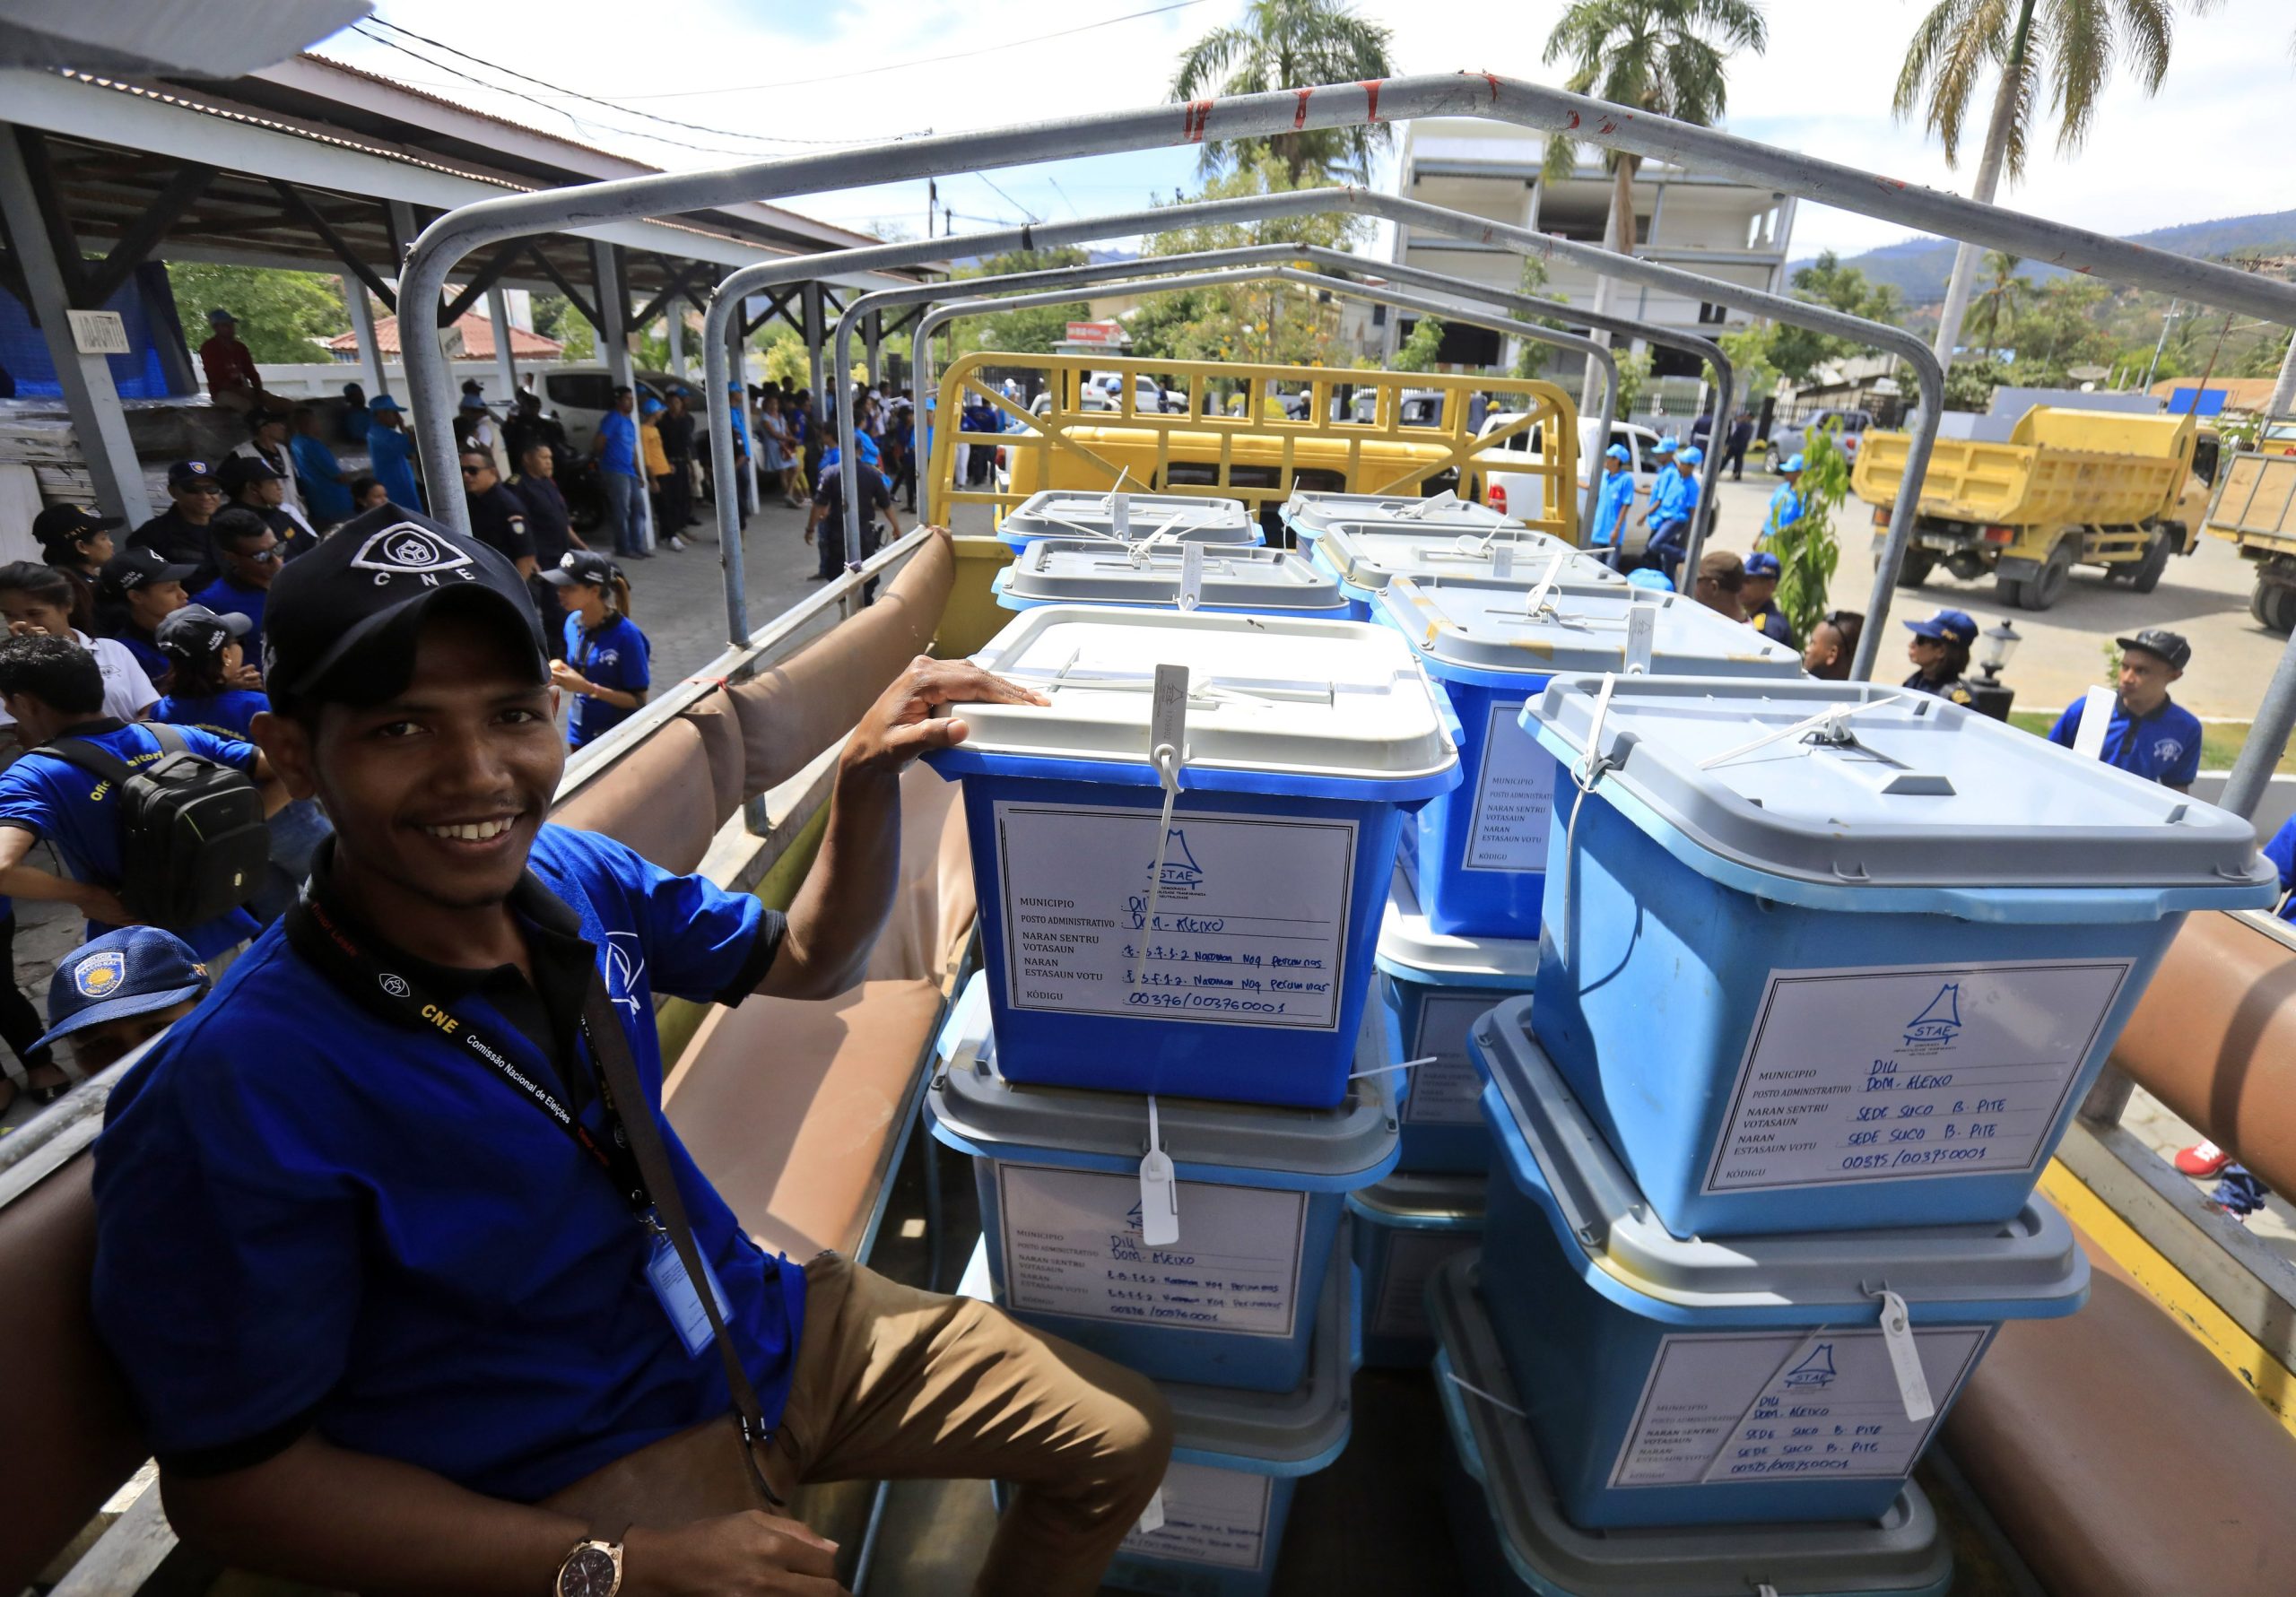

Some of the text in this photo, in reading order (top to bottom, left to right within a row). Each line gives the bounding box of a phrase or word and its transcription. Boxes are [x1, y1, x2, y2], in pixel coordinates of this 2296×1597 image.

[374, 568, 475, 586] CNE
[1492, 777, 1534, 785] MUNICIPIO
[1484, 825, 1510, 833] NARAN
[1482, 835, 1520, 843] ESTASAUN
[1159, 869, 1194, 881] STAE
[1020, 898, 1074, 908] MUNICIPIO
[1021, 915, 1115, 928] POSTO ADMINISTRATIVO
[1022, 932, 1100, 944] NARAN SENTRU
[1022, 943, 1074, 953] VOTASAUN
[1024, 957, 1058, 967] NARAN
[1025, 968, 1103, 981] ESTASAUN VOTU
[1026, 990, 1063, 1001] KÓDIGU
[1915, 1026, 1952, 1037] STAE
[421, 1003, 459, 1034] CNE
[466, 1035, 505, 1068] Comissão
[504, 1063, 537, 1093] Nacional
[535, 1089, 546, 1100] de
[544, 1096, 571, 1124] Eleições
[1759, 1069, 1817, 1081] MUNICIPIO
[1752, 1085, 1851, 1098] POSTO ADMINISTRATIVO
[1747, 1104, 1829, 1116] NARAN SENTRU
[1857, 1106, 1889, 1122] SEDE
[1898, 1105, 1934, 1118] SUCO
[1977, 1099, 2007, 1114] PITE
[1744, 1118, 1798, 1129] VOTASAUN
[1738, 1133, 1775, 1143] NARAN
[1848, 1129, 1881, 1145] SEDE
[1889, 1128, 1926, 1142] SUCO
[1970, 1124, 1997, 1139] PITE
[1734, 1142, 1817, 1155] ESTASAUN VOTU
[1726, 1168, 1766, 1178] KÓDIGU
[1016, 1229, 1064, 1241] MUNICIPIO
[1019, 1254, 1048, 1263] NARAN
[1020, 1263, 1064, 1273] VOTASAUN
[1021, 1272, 1049, 1281] NARAN
[1856, 1425, 1883, 1436] PITE
[1851, 1442, 1880, 1454] PITE
